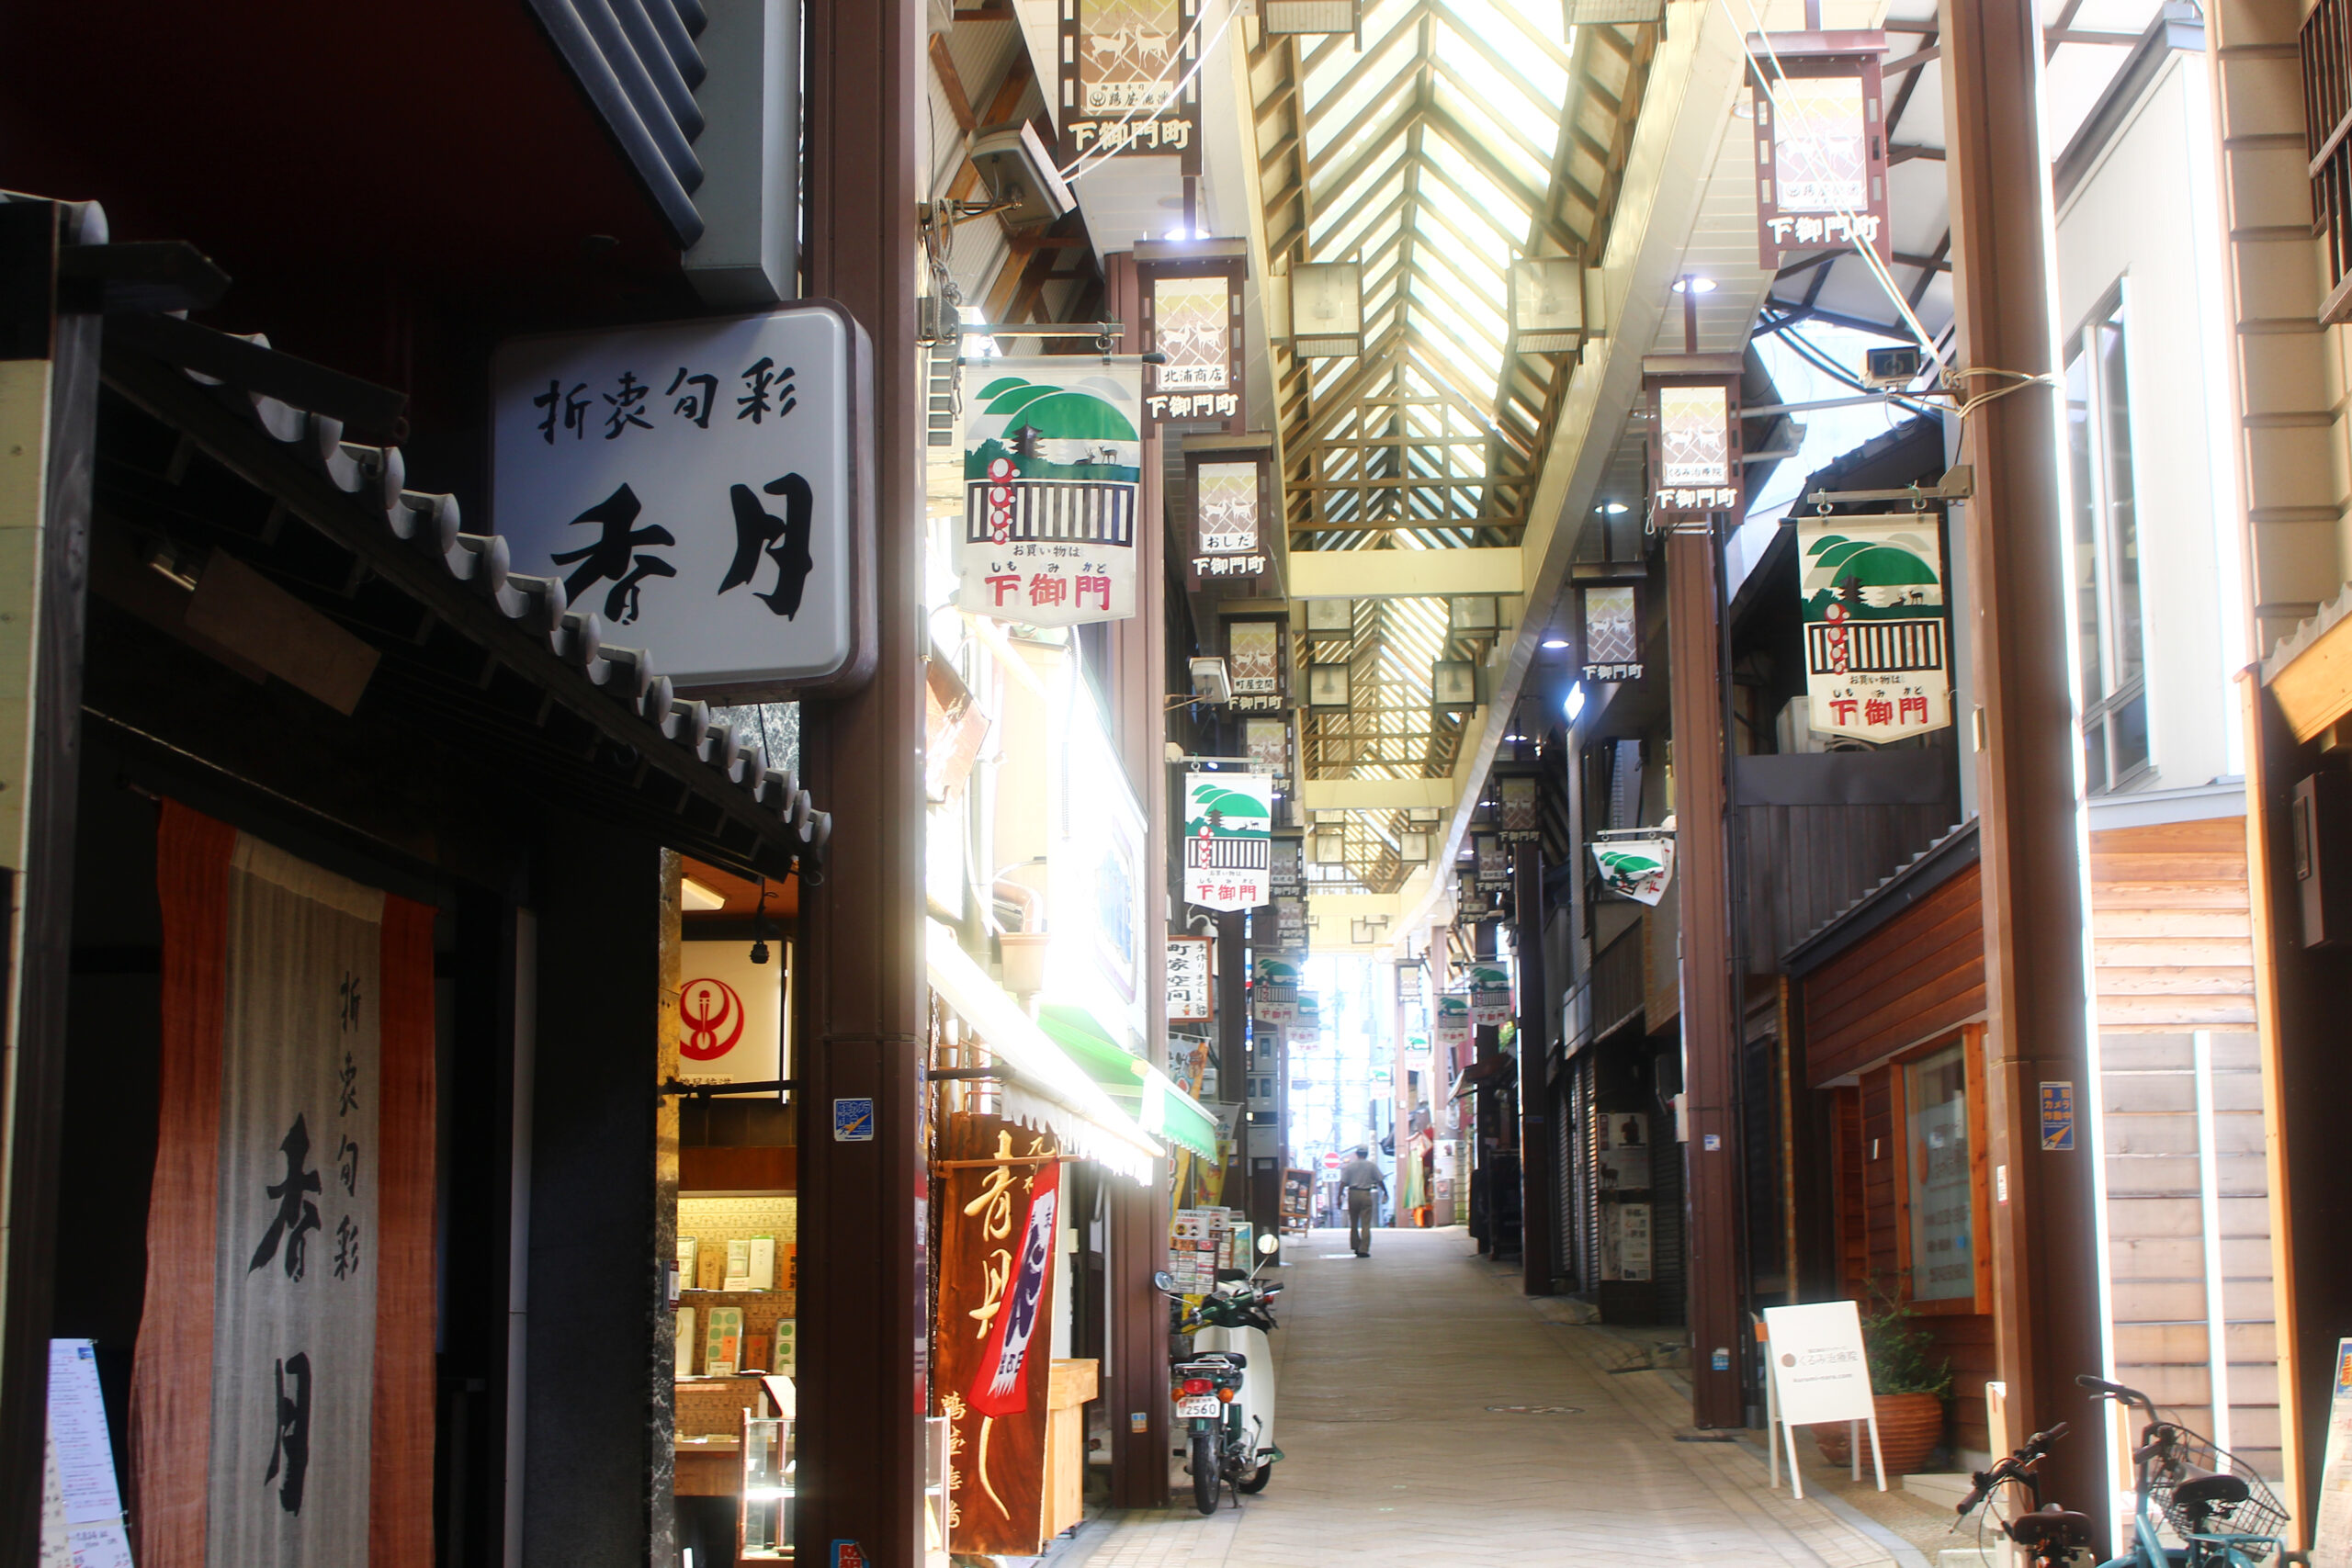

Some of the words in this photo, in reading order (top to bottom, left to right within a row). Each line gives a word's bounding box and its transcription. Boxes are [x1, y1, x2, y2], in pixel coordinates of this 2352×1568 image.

[1068, 118, 1193, 152] 下御門町
[1767, 215, 1881, 244] 下御門町
[1164, 367, 1223, 383] 北浦商店
[1147, 393, 1238, 419] 下御門町
[1656, 487, 1738, 510] 下御門町
[551, 472, 814, 626] 香月
[1206, 534, 1252, 548] おしだ
[1012, 544, 1081, 558] お買い物は
[990, 561, 1018, 572] しも
[1047, 563, 1060, 572] み
[1082, 561, 1108, 573] かど
[1192, 556, 1267, 577] 下御門町
[984, 573, 1112, 612] 下御門
[1582, 663, 1645, 682] 下御門町
[1849, 675, 1902, 685] お買い物は
[1832, 687, 1854, 698] しも
[1874, 688, 1886, 698] み
[1903, 685, 1924, 696] かど
[1227, 694, 1283, 711] 下御門町
[1828, 695, 1929, 727] 下御門
[1197, 884, 1257, 902] 下御門
[247, 1112, 322, 1517] 香月
[1186, 1404, 1217, 1416] 2560
